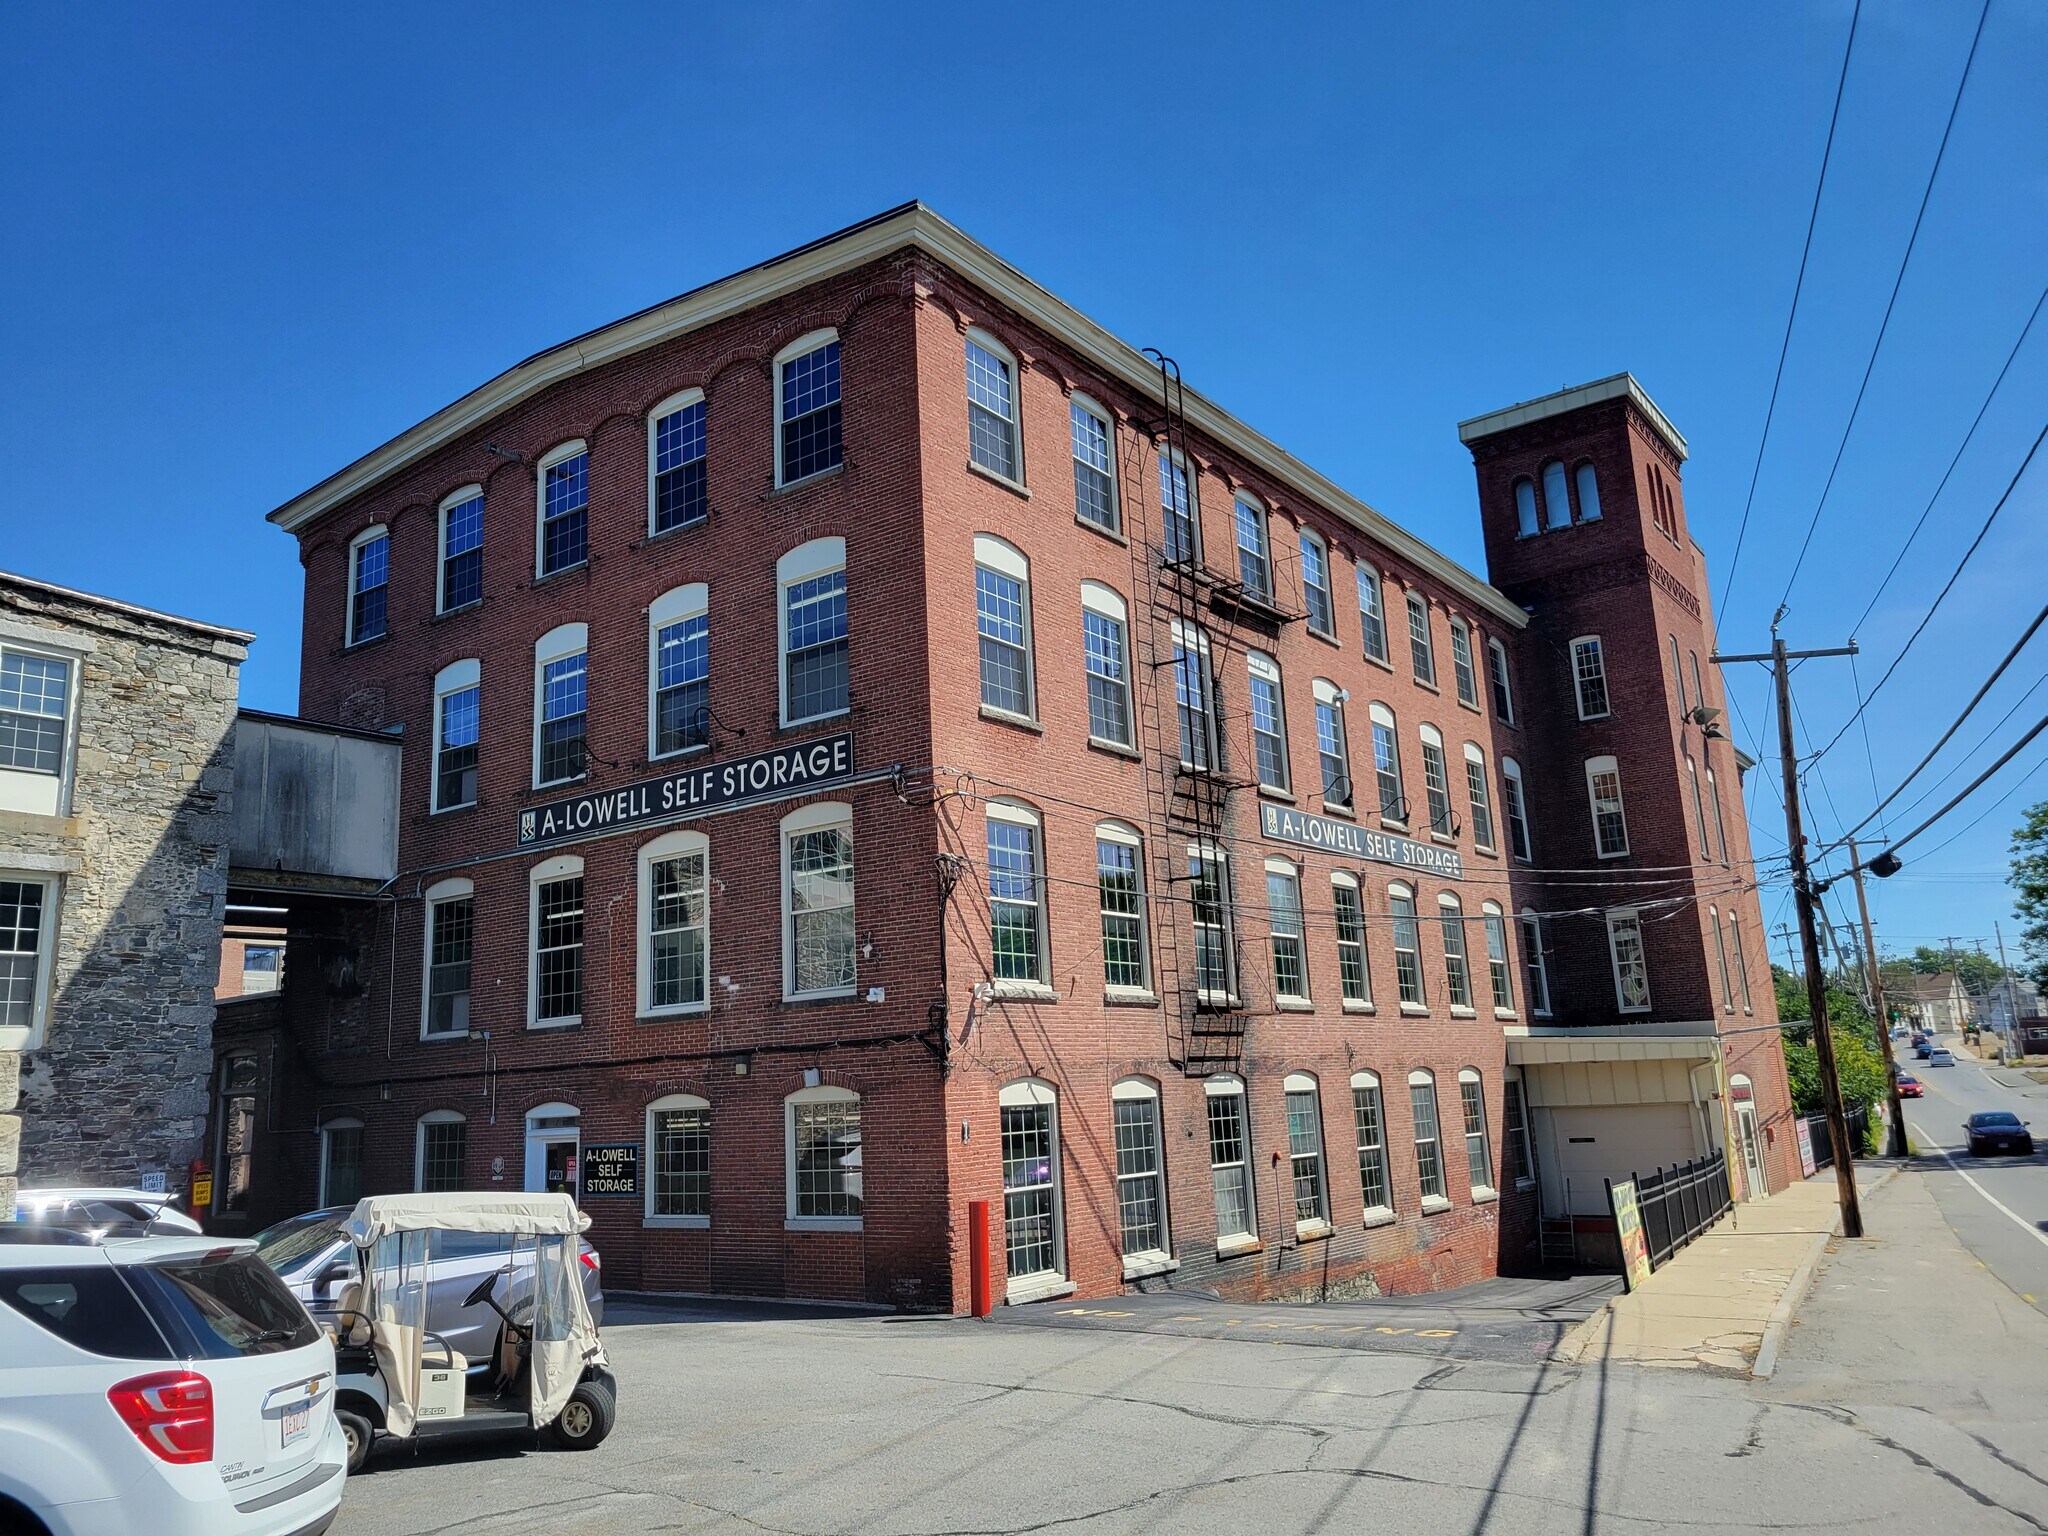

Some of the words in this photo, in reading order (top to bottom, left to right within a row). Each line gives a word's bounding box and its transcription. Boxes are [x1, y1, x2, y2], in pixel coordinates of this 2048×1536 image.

[541, 787, 651, 836] A-LOWELL
[662, 772, 714, 809] SELF
[722, 740, 846, 796] STORAGE
[1283, 813, 1362, 852] A-LOWELL
[1367, 833, 1397, 860] SELF
[1402, 842, 1460, 875] STORAGE
[586, 1149, 636, 1162] A-LOWELL
[598, 1164, 623, 1177] SELF
[143, 1175, 164, 1183] SPEED
[587, 1179, 634, 1192] STORAGE
[1054, 1309, 1136, 1317] NO
